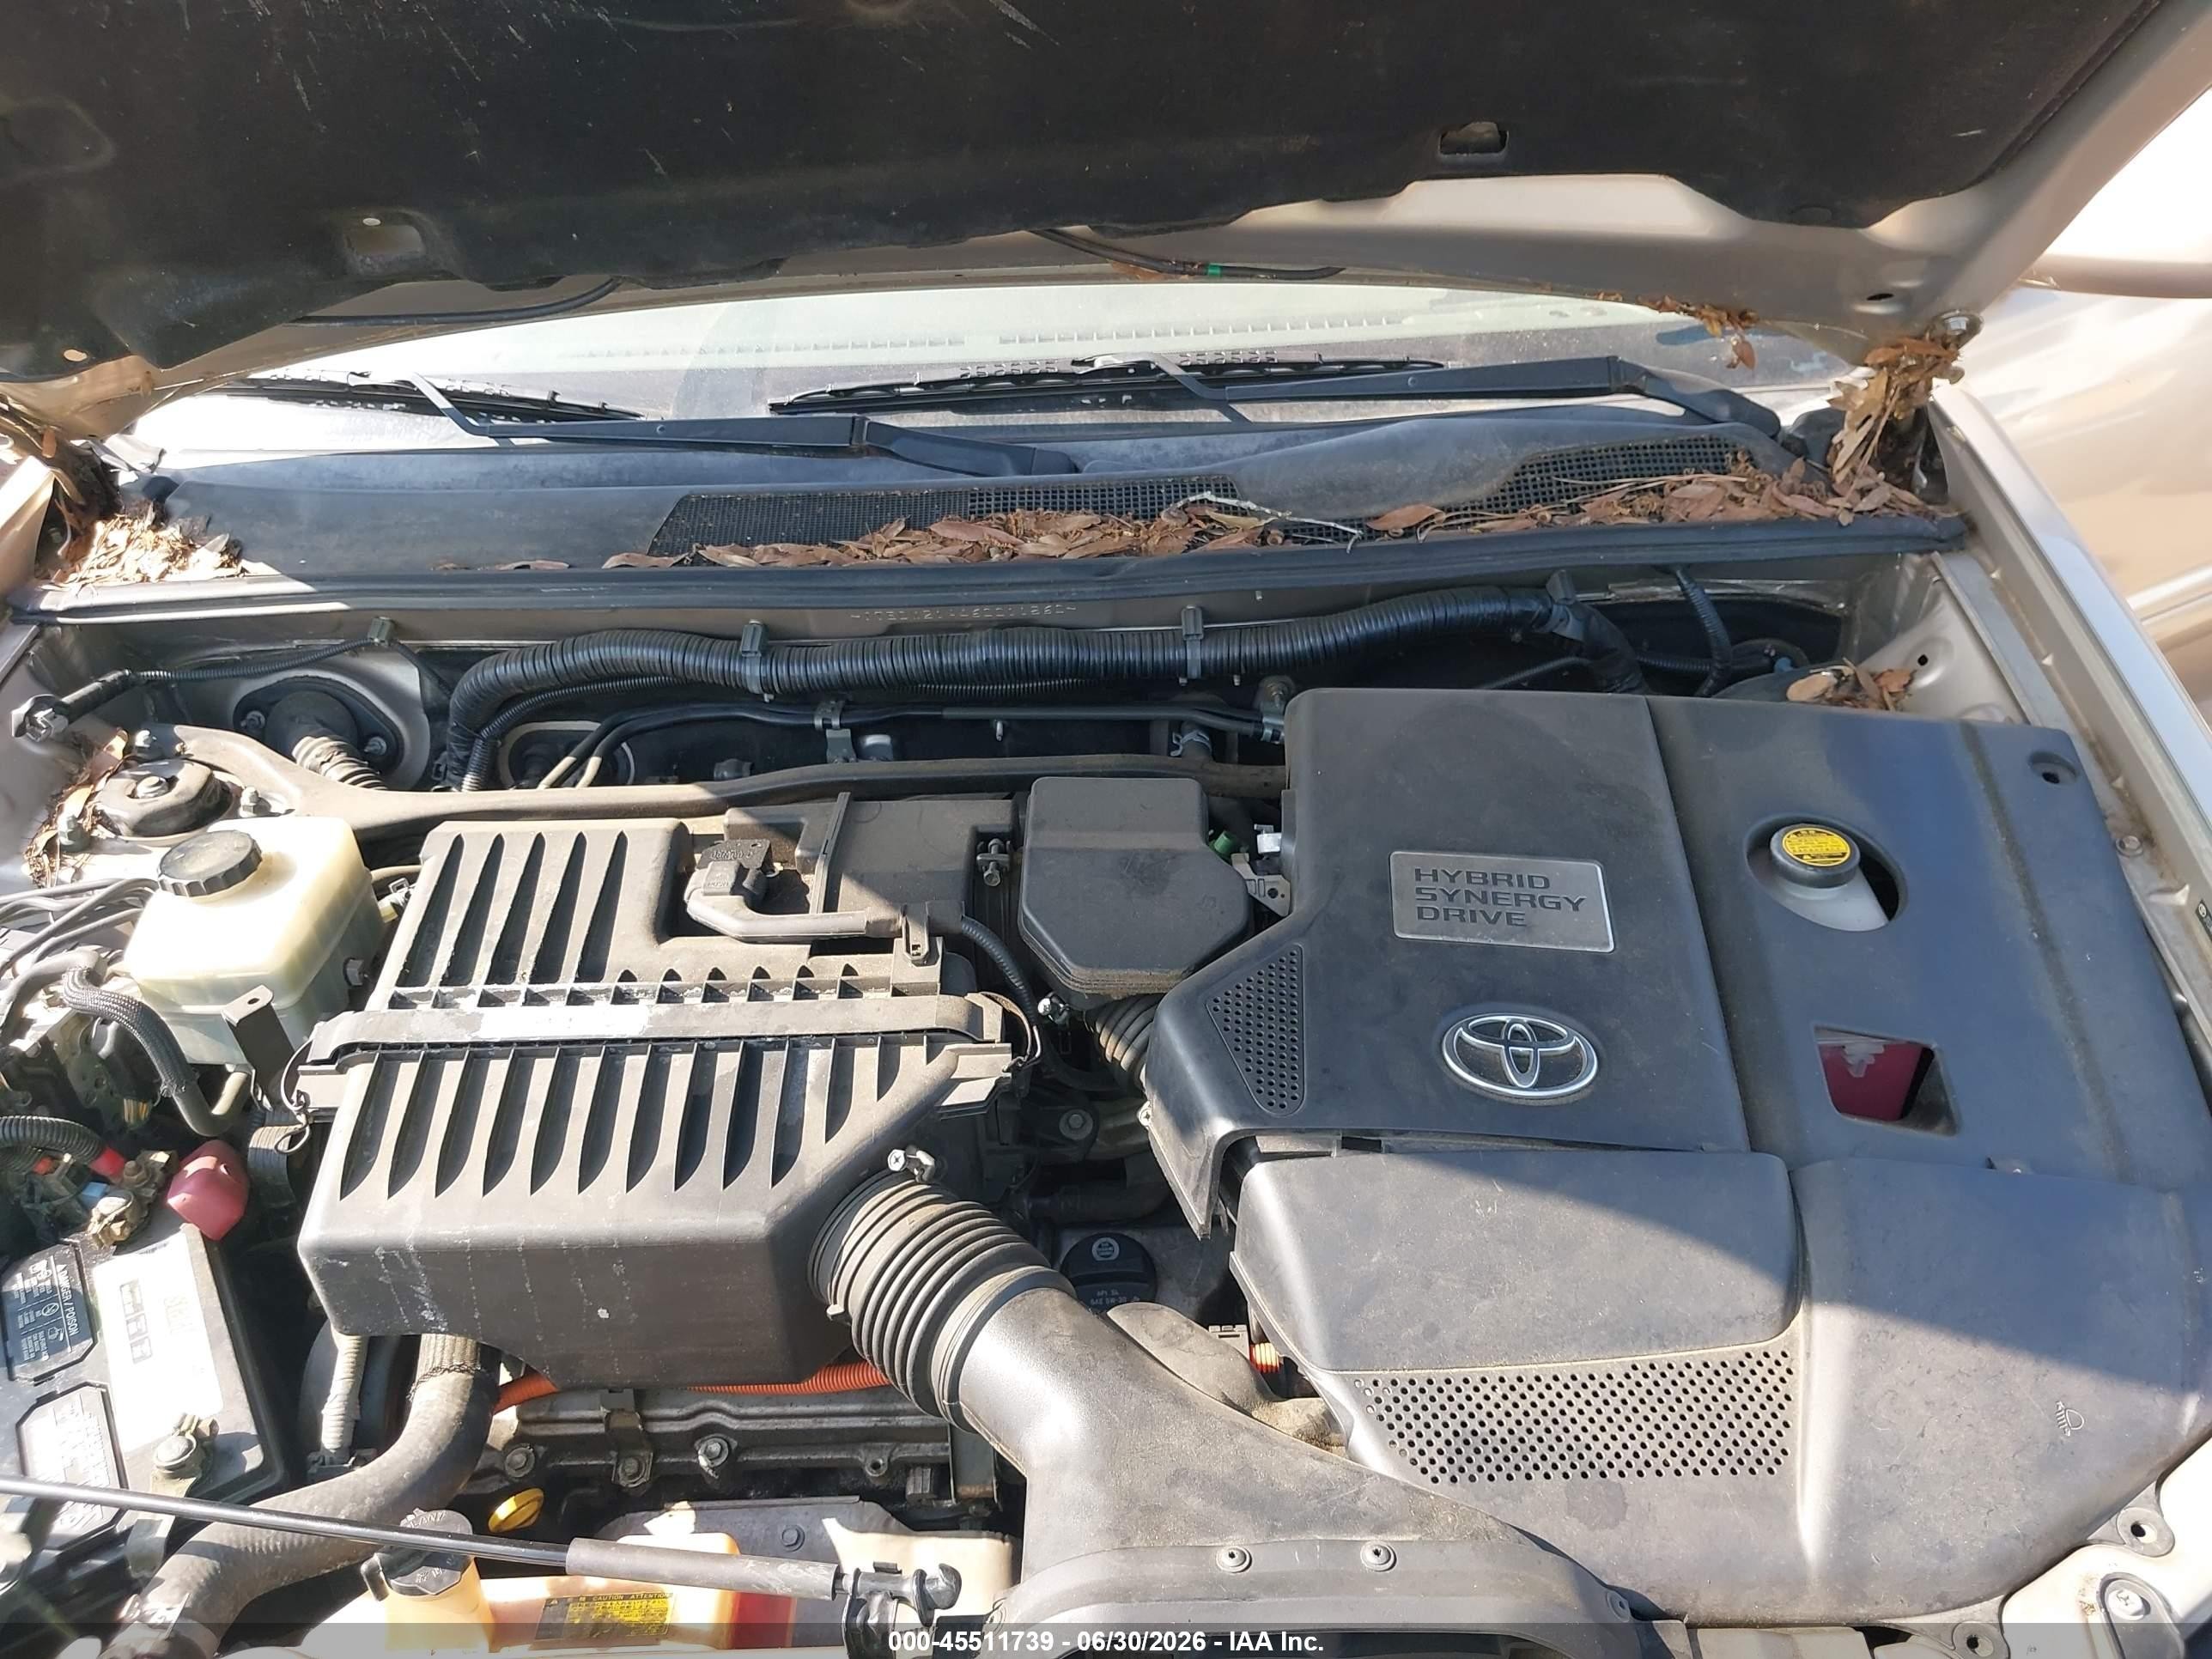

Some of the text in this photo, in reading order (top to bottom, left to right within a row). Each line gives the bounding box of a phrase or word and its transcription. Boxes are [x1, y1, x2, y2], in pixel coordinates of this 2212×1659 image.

[1414, 868, 1550, 890] HYBRID
[1414, 887, 1587, 912] SYNERGY
[1416, 906, 1526, 927] DRIVE
[58, 1270, 72, 1302] DANGER
[64, 1306, 80, 1336] POISON
